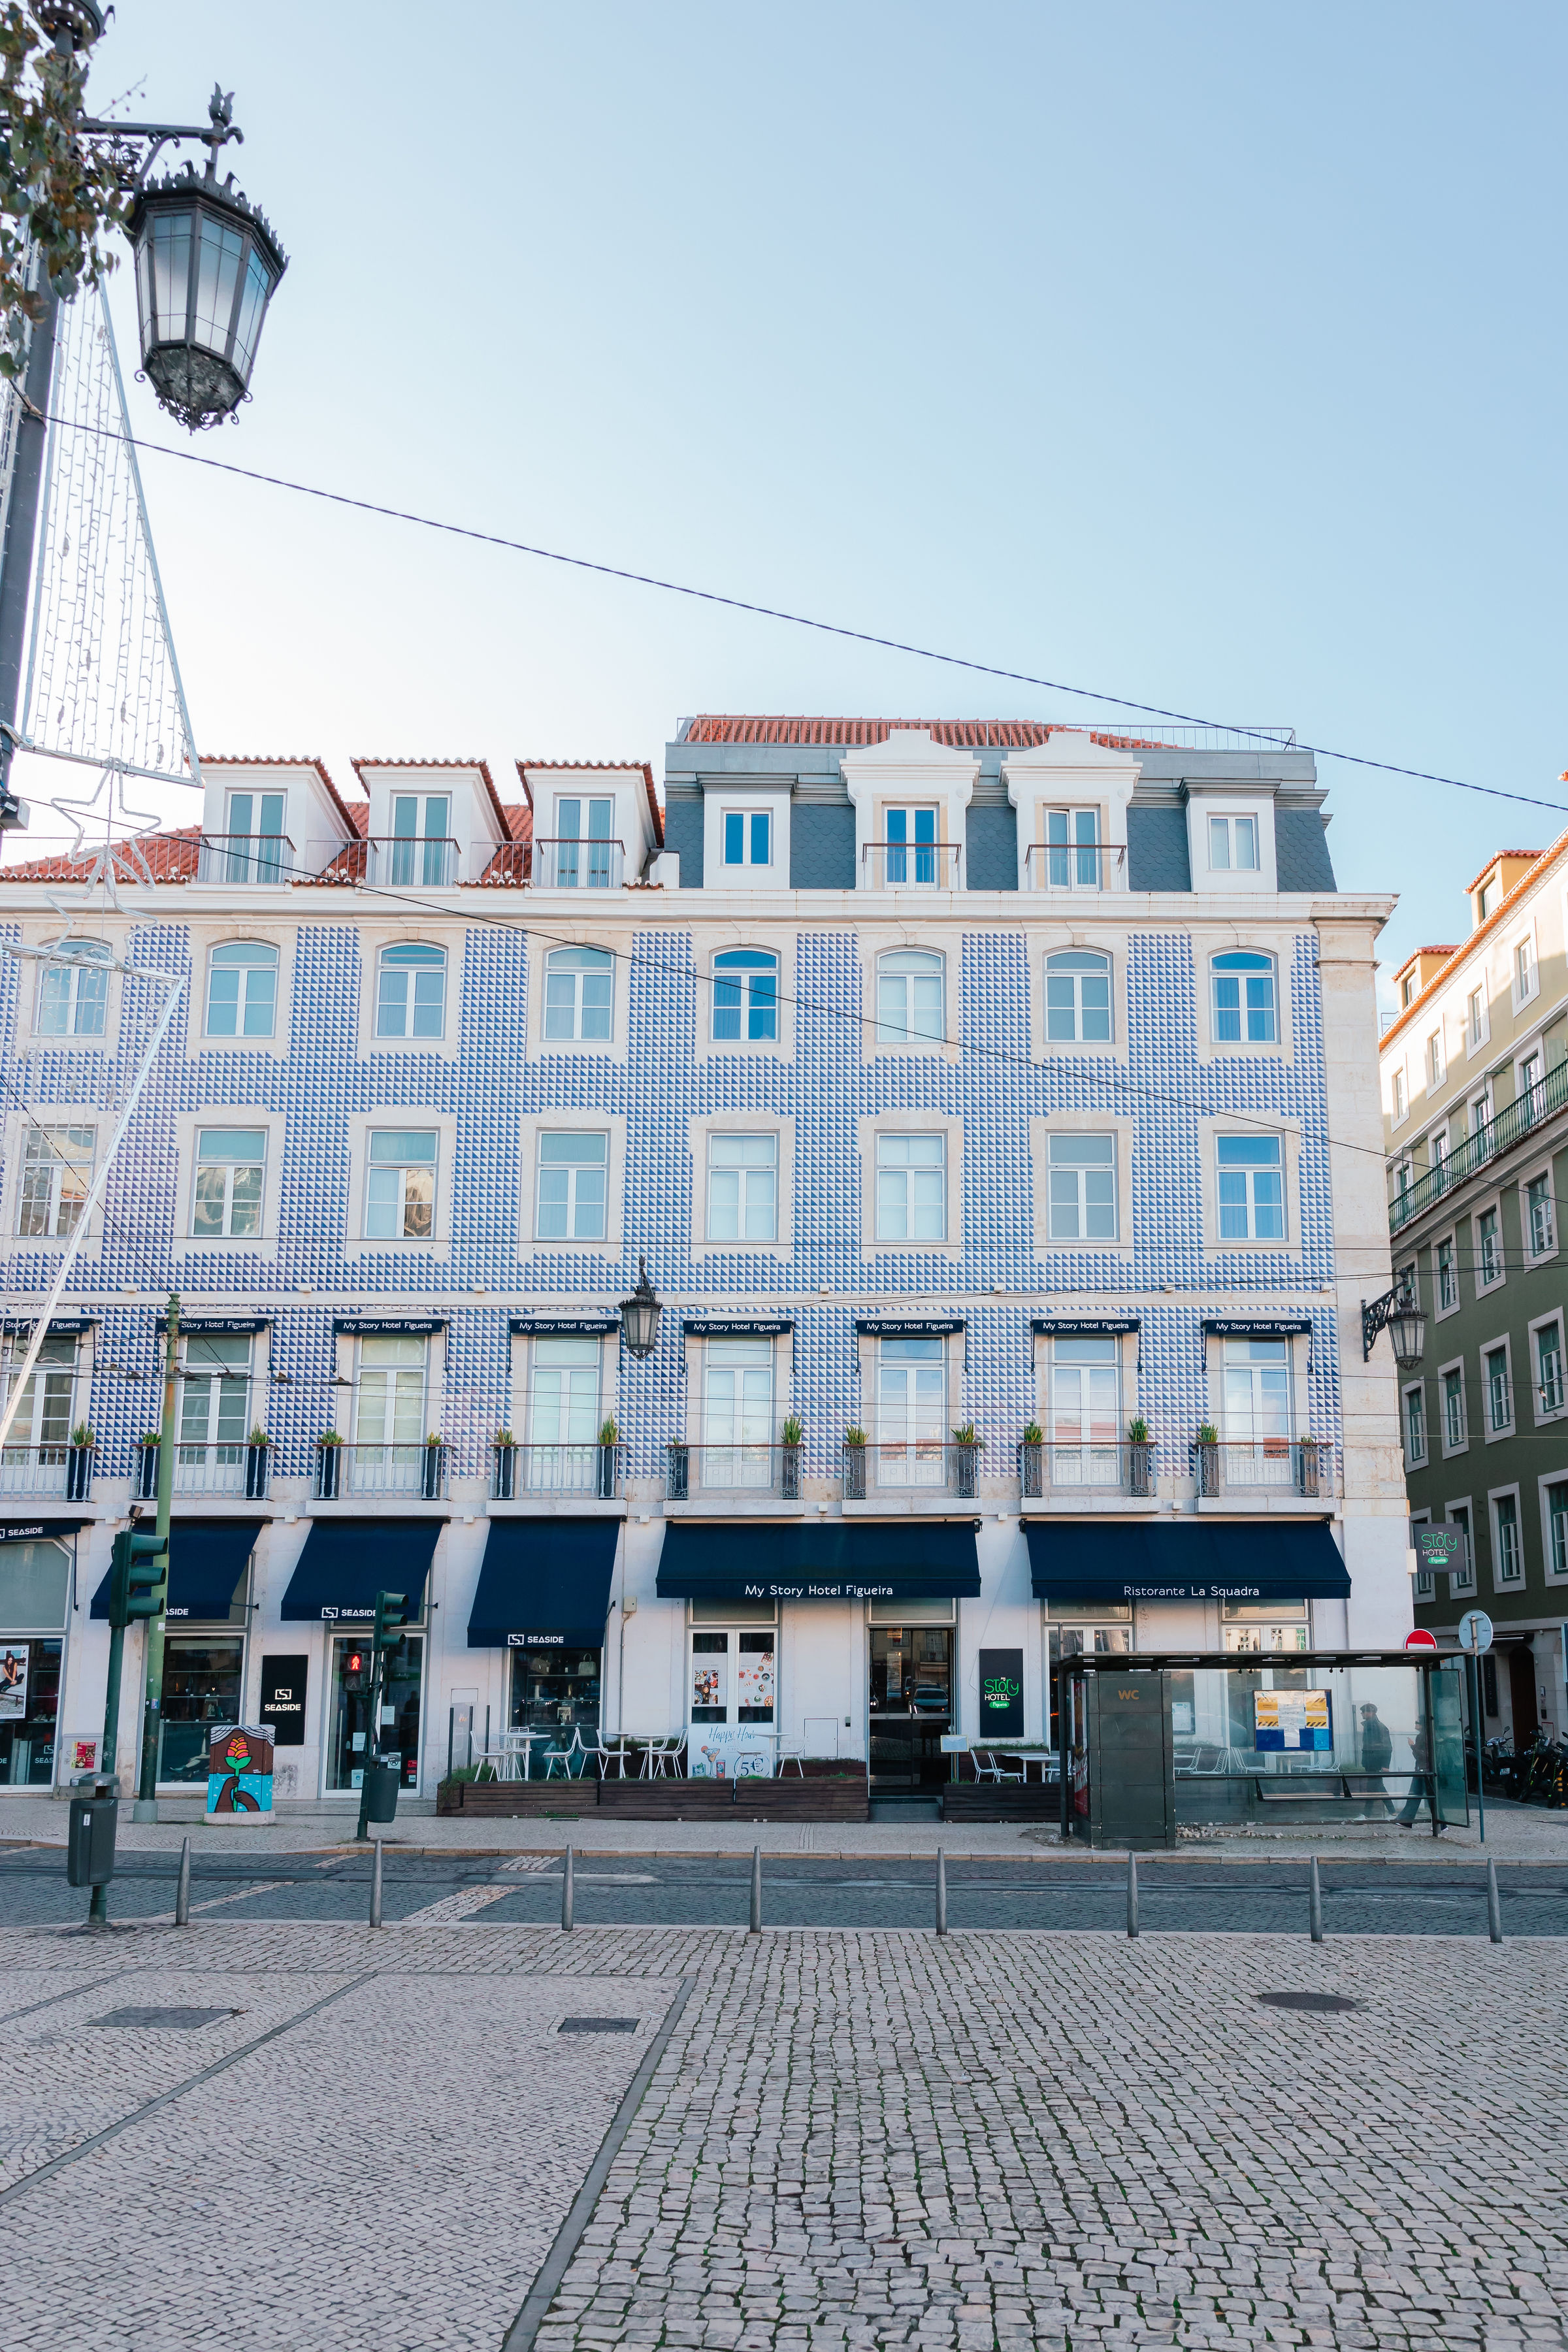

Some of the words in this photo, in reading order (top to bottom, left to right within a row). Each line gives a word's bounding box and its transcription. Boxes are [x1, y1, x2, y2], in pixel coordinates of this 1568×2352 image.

[52, 1321, 80, 1330] Figueira
[181, 1321, 202, 1330] Story
[227, 1321, 255, 1330] Figueira
[343, 1322, 357, 1330] My
[358, 1322, 380, 1330] Story
[404, 1322, 433, 1330] Figueira
[519, 1322, 532, 1331] My
[534, 1322, 555, 1330] Story
[580, 1322, 608, 1331] Figueira
[693, 1323, 707, 1331] My
[708, 1323, 729, 1331] Story
[753, 1323, 781, 1331] Figueira
[866, 1322, 879, 1331] My
[881, 1322, 902, 1331] Story
[926, 1322, 954, 1331] Figueira
[1043, 1322, 1056, 1330] My
[1058, 1322, 1078, 1330] Story
[1102, 1322, 1130, 1330] Figueira
[1216, 1322, 1229, 1331] My
[1230, 1322, 1251, 1331] Story
[1275, 1322, 1301, 1331] Figueira
[8, 1526, 43, 1537] SEASIDE
[1421, 1533, 1458, 1552] Story
[745, 1585, 765, 1597] My
[770, 1585, 804, 1598] Story
[809, 1585, 840, 1595] Hotel
[846, 1585, 893, 1597] Figueira
[1124, 1586, 1185, 1596] Ristorante
[1191, 1586, 1205, 1596] La
[1211, 1586, 1260, 1598] Squadra
[984, 1678, 1019, 1696] Story
[1118, 1690, 1139, 1700] WC
[264, 1703, 301, 1712] SEASIDE
